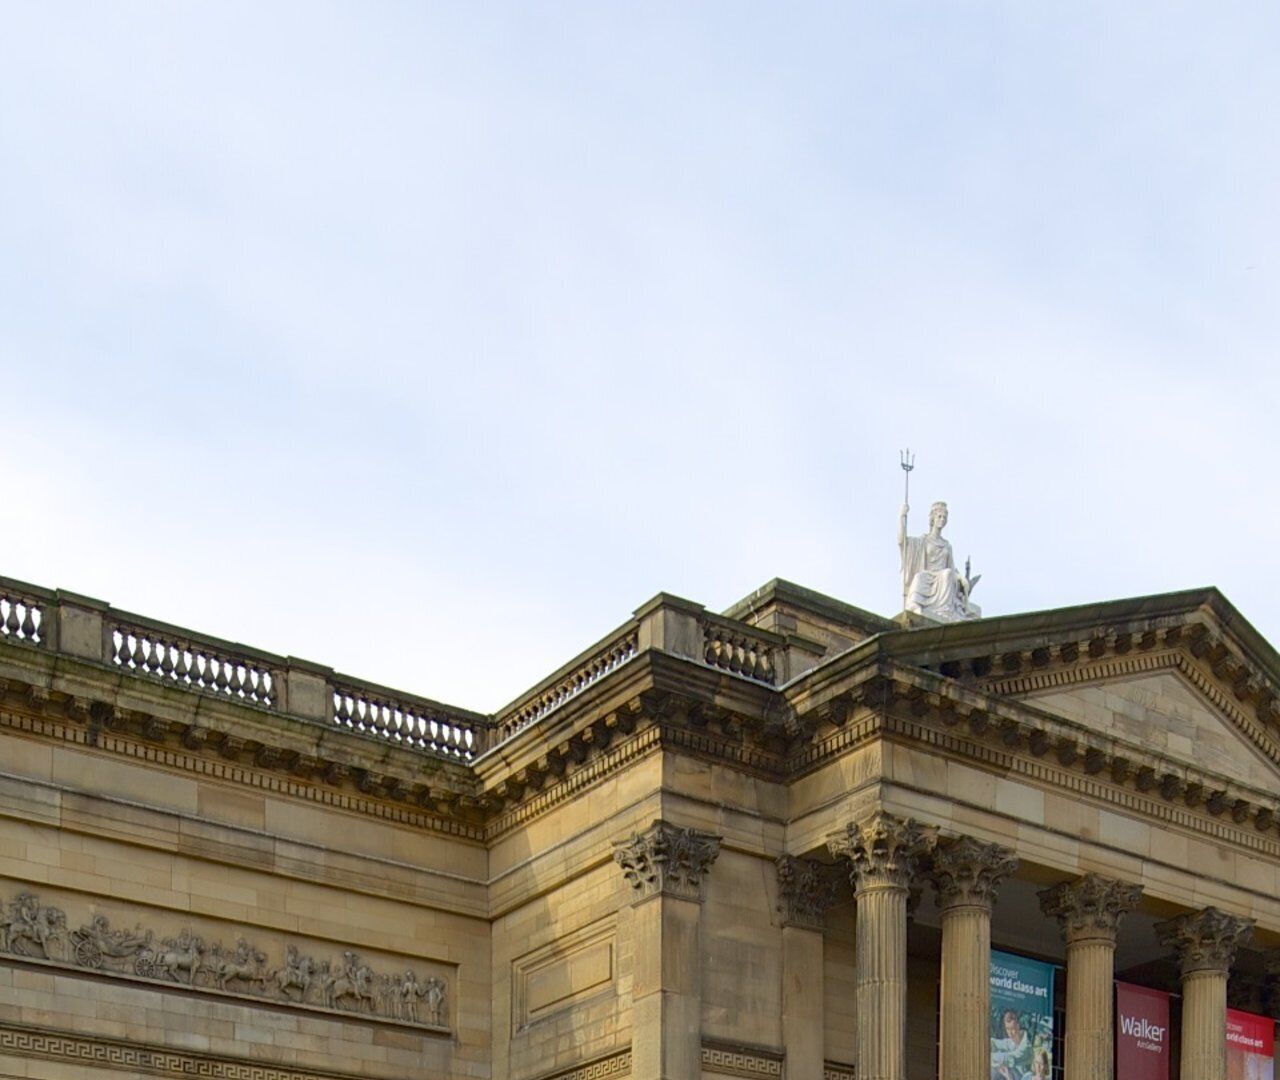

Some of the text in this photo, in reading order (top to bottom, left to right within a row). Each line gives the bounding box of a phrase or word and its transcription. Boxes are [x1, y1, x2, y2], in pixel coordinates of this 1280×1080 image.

[1013, 980, 1034, 995] class
[1035, 986, 1048, 998] art
[1120, 1013, 1166, 1042] Walker
